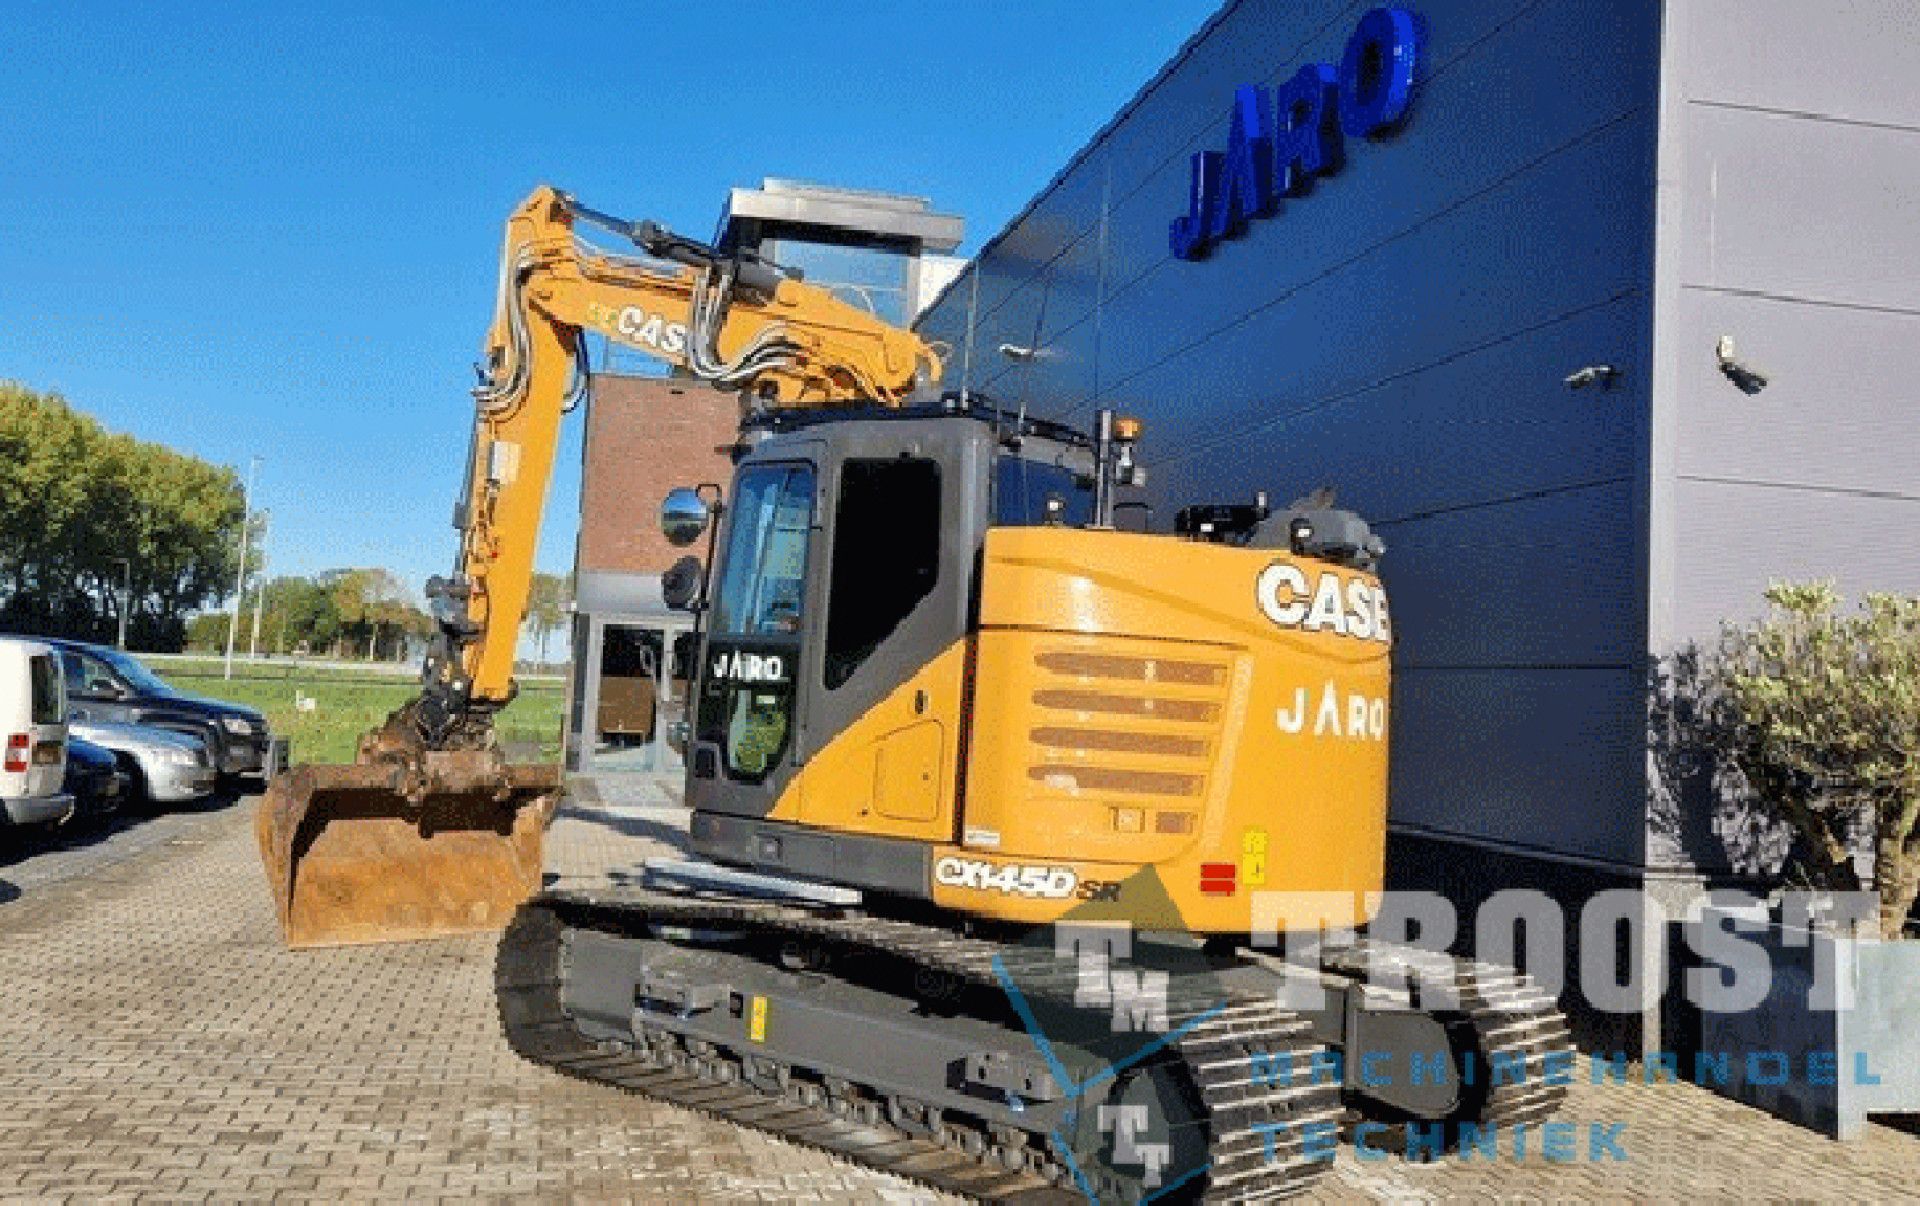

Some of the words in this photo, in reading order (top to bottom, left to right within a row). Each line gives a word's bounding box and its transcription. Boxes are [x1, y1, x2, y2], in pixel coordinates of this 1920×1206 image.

[1169, 8, 1417, 260] JARO
[618, 306, 690, 352] CAS
[1256, 562, 1389, 641] CASE
[713, 650, 782, 682] JARO
[1276, 678, 1385, 741] JARO
[934, 856, 1078, 898] CX145D
